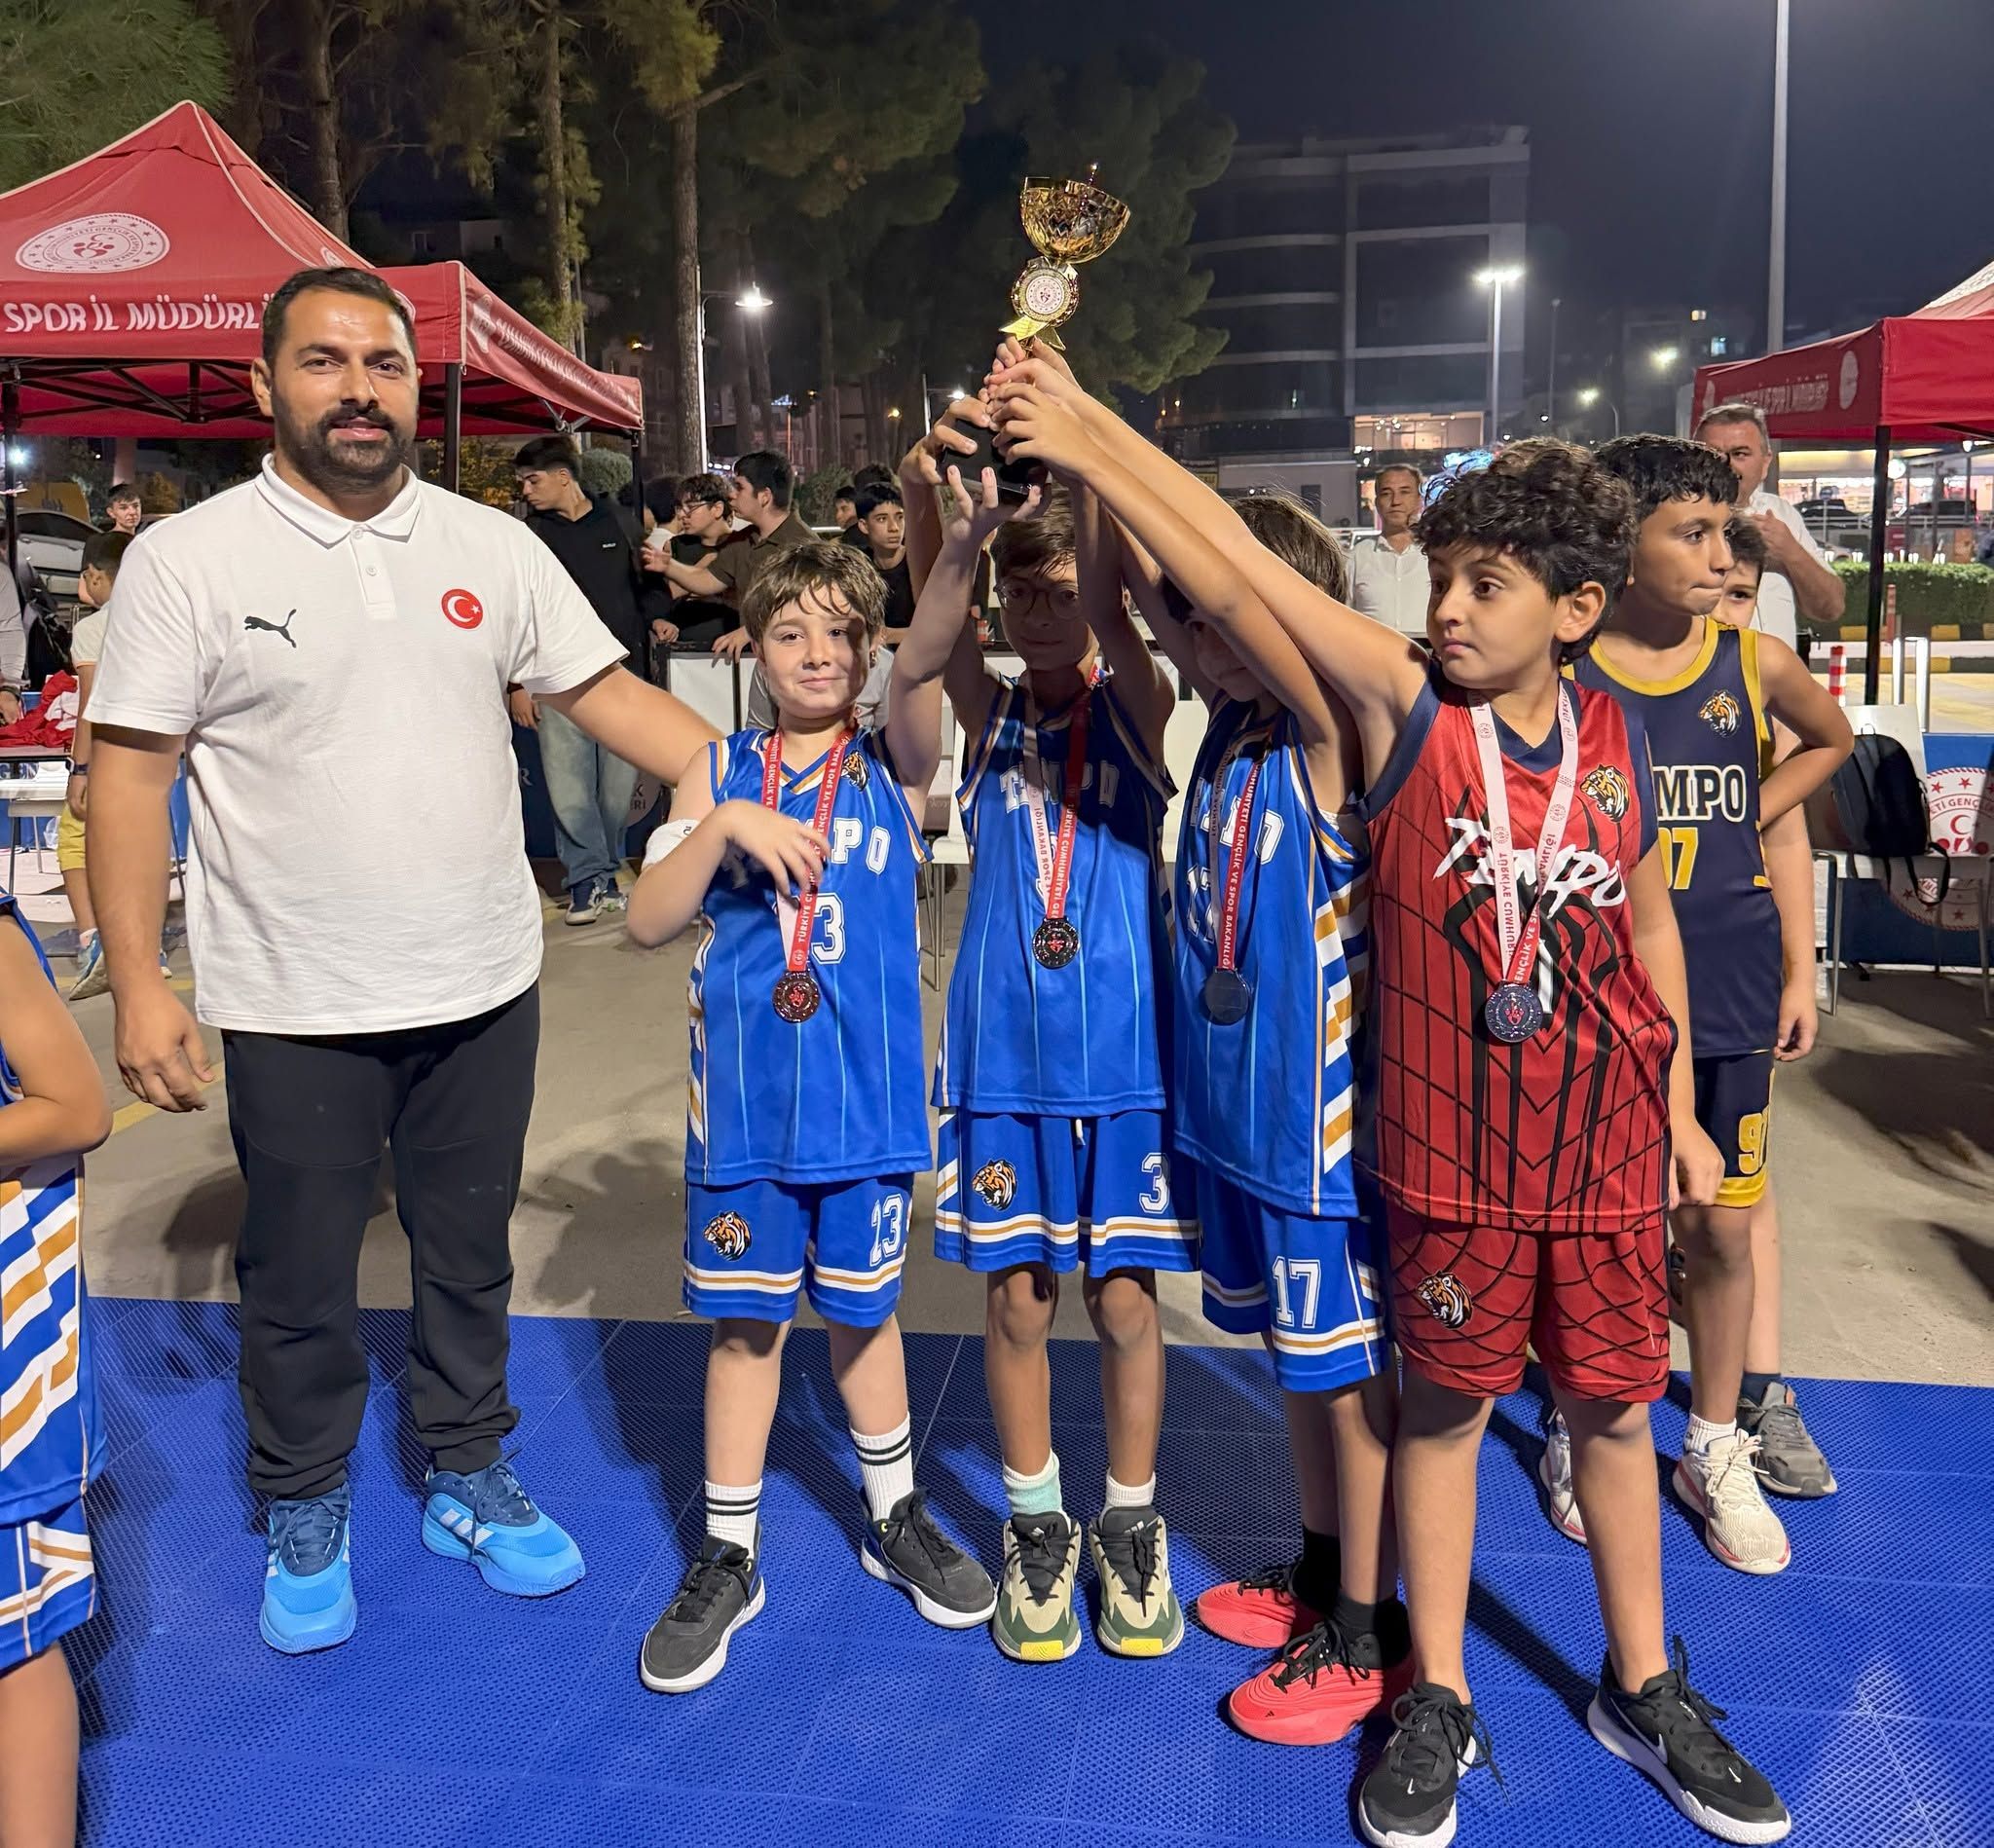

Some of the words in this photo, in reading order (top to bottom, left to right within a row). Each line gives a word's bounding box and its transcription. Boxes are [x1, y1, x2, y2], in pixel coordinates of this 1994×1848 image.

[4, 302, 87, 333] SPOR
[91, 294, 120, 331] İL
[817, 801, 830, 834] ENÇLİK
[826, 769, 835, 789] SPOR
[1652, 765, 1747, 822] MPO
[1948, 796, 1986, 812] GENÇ
[1054, 840, 1069, 901] CUMHURİYETİ
[1233, 826, 1246, 869] GENÇLİK
[1226, 886, 1237, 912] SPOR
[1230, 871, 1239, 884] VE
[798, 904, 812, 942] TÜRKİYE
[1221, 915, 1233, 969] BAKANLIĞI
[1514, 942, 1532, 982] ENÇLİK
[1526, 927, 1535, 940] VE
[1139, 1152, 1168, 1213] 3
[869, 1193, 905, 1268] 23
[1273, 1256, 1321, 1329] 17
